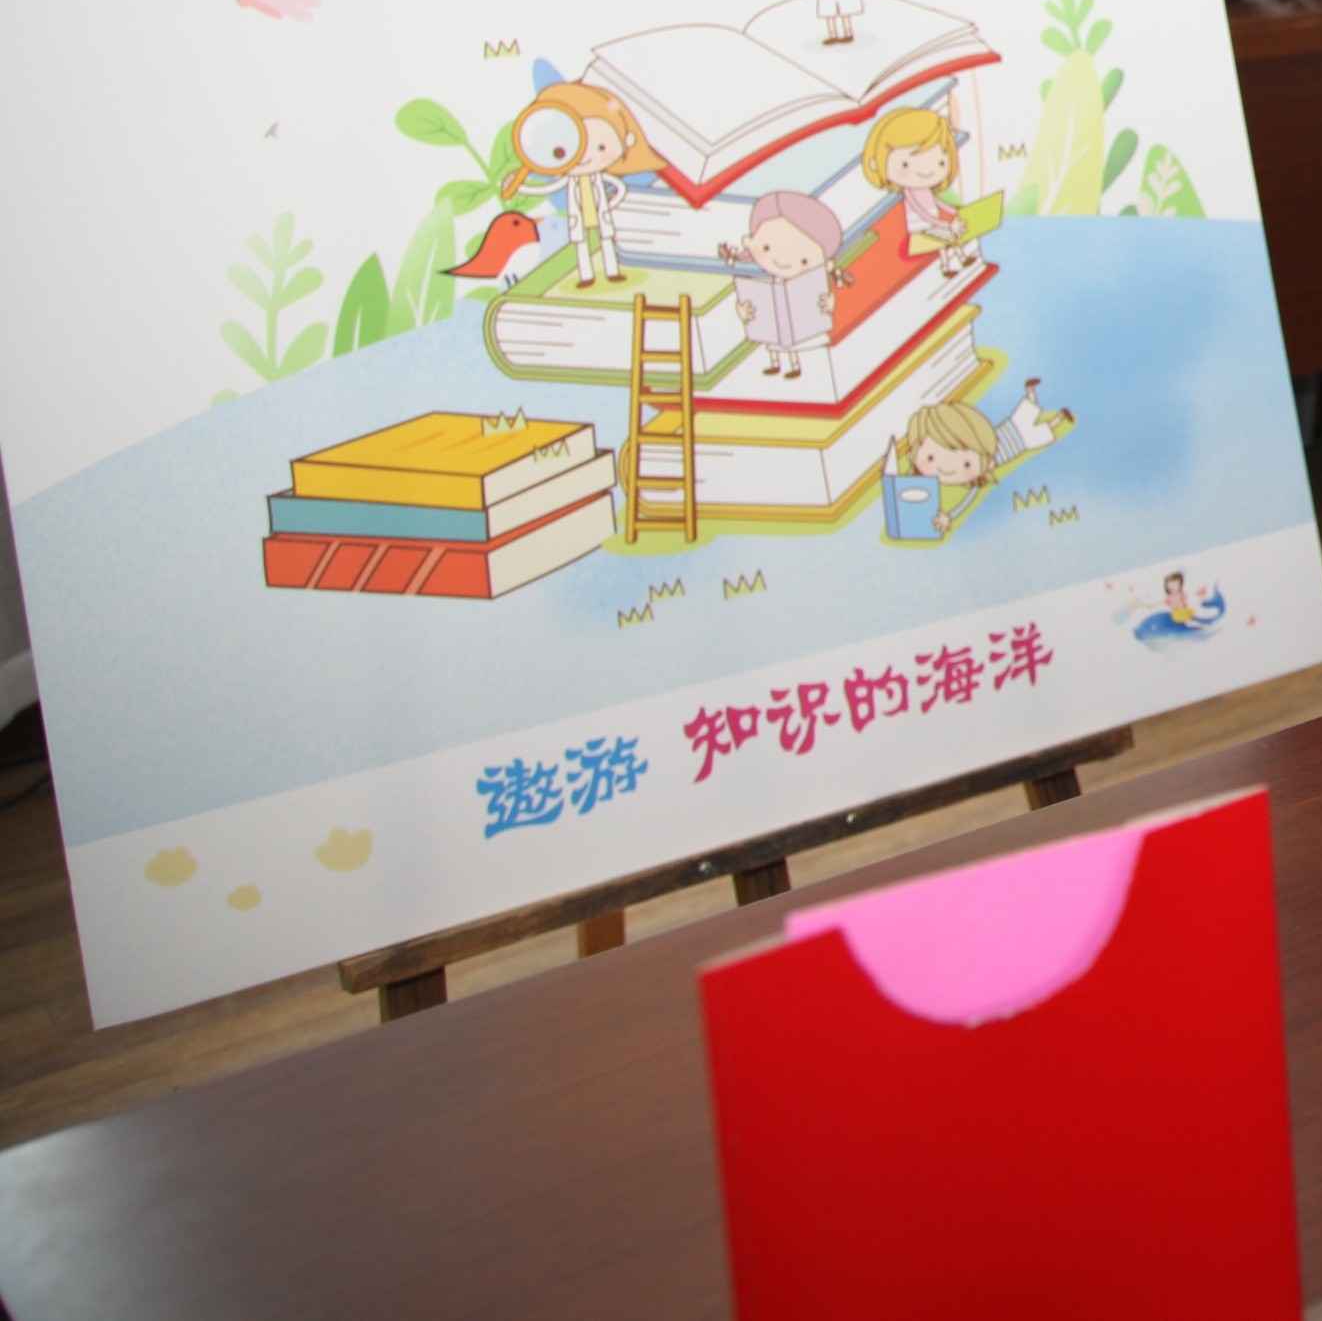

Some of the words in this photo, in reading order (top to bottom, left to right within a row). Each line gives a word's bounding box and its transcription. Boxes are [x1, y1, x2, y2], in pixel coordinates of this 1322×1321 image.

[475, 736, 649, 839] 遨游
[683, 622, 1054, 783] 知识的海洋
